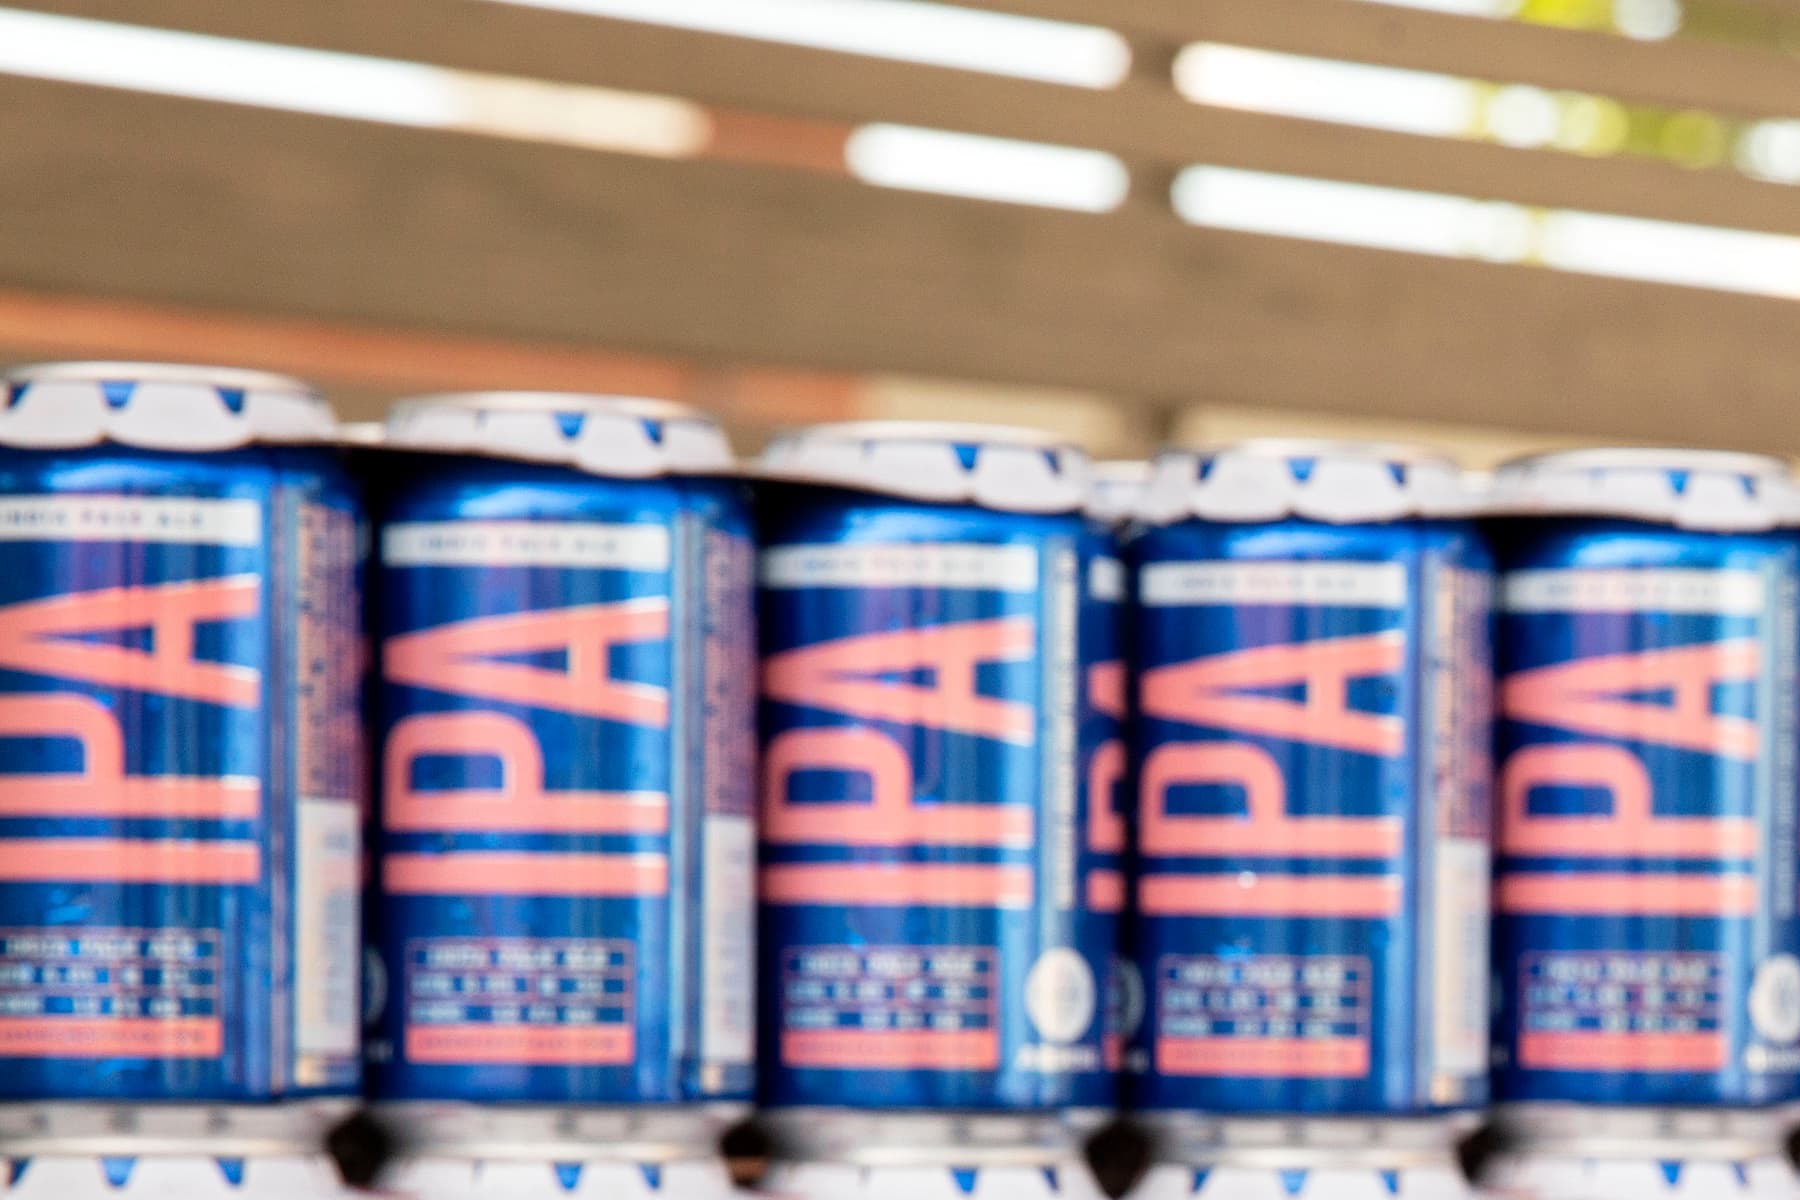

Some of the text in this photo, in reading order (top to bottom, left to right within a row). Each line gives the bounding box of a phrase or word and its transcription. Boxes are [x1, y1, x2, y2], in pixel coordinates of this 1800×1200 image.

[0, 572, 260, 884] IPA
[382, 595, 669, 897] IPA
[760, 615, 1034, 908] IPA
[1137, 629, 1405, 917] IPA
[1495, 637, 1760, 916] IPA
